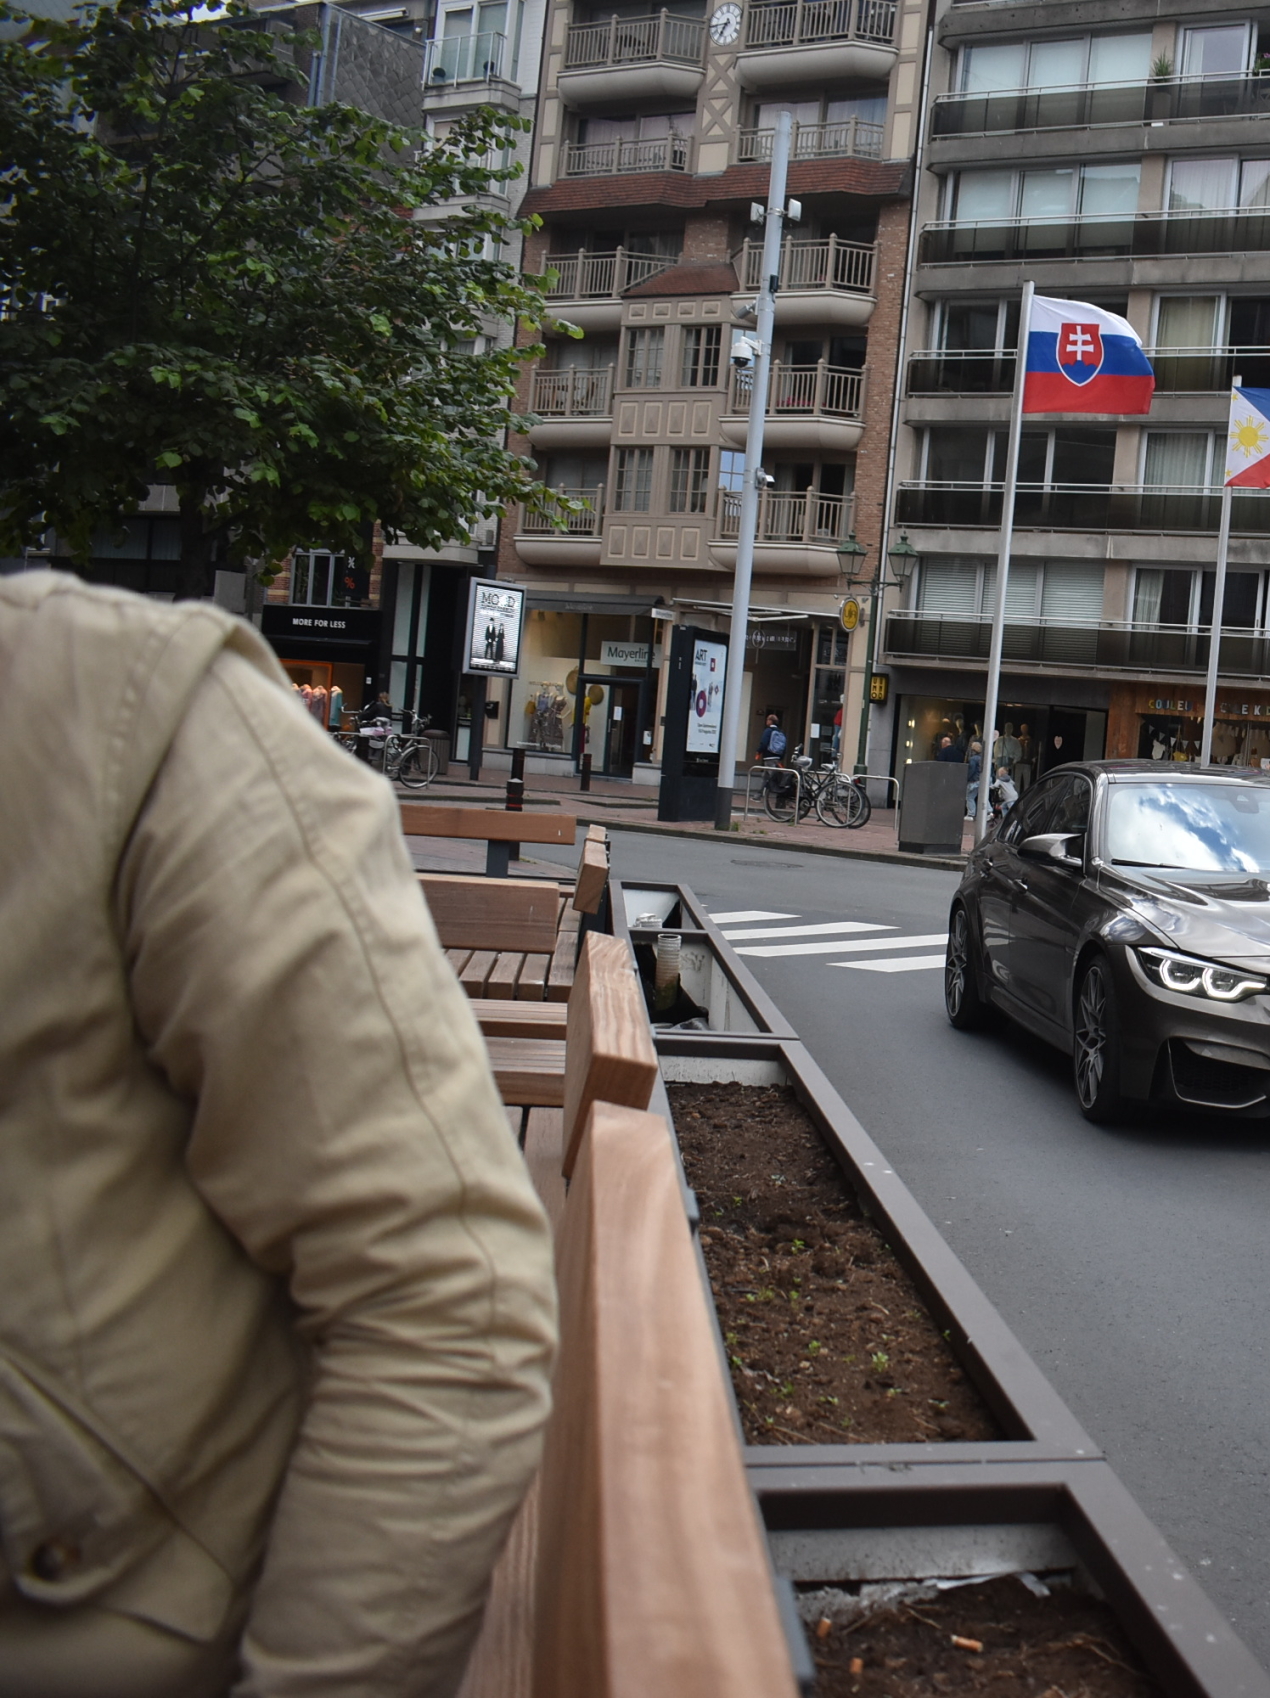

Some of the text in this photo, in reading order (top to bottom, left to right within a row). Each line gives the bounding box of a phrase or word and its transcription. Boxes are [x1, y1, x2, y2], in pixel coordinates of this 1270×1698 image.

[480, 592, 516, 608] MOD
[292, 617, 346, 629] MORE FOR LESS
[695, 648, 708, 661] ART
